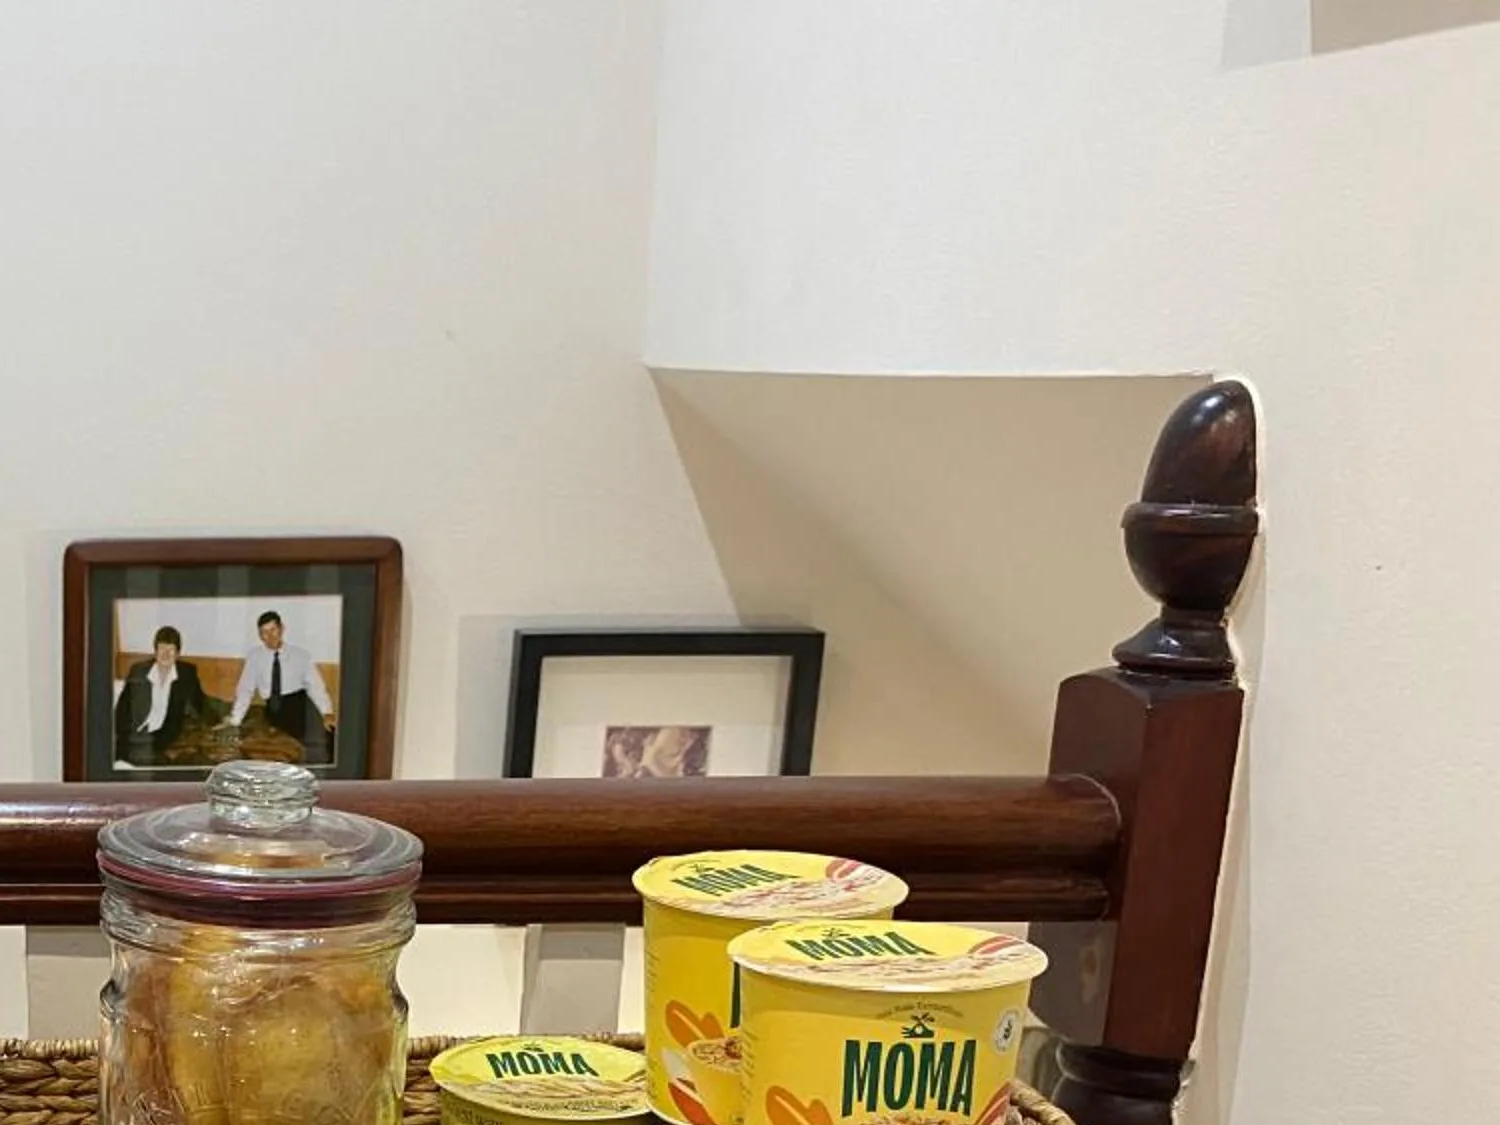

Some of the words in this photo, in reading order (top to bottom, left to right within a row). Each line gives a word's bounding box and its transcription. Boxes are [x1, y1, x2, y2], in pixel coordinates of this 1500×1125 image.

[670, 864, 802, 896] MOMA
[786, 931, 939, 960] MOMA
[486, 1051, 599, 1078] MOMA
[841, 1039, 977, 1117] MOMA
